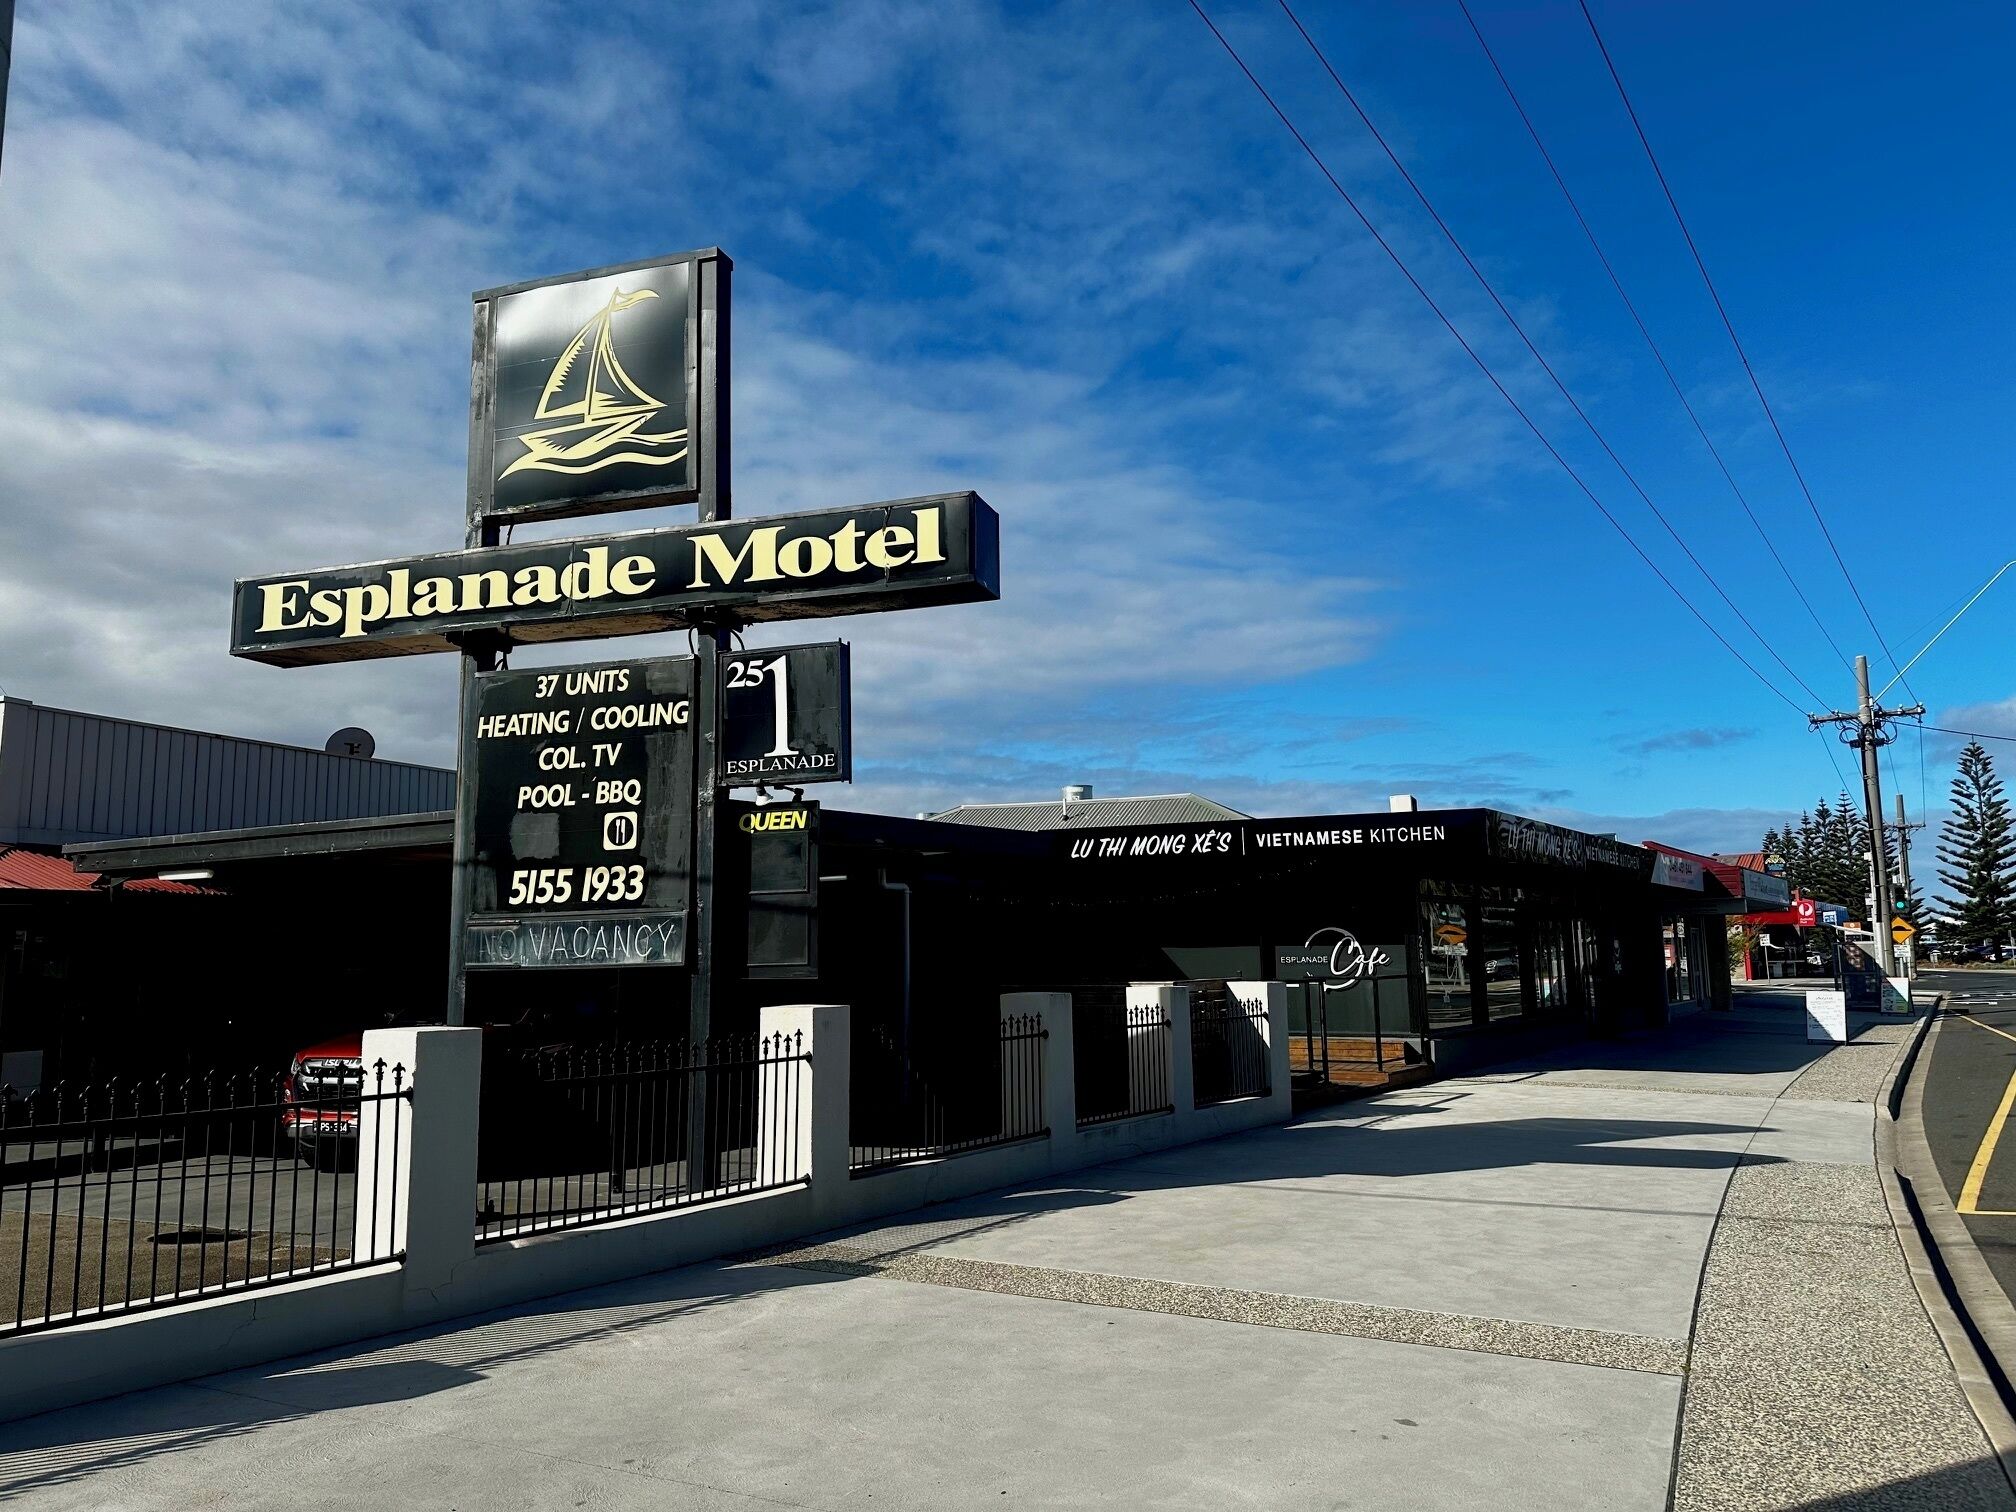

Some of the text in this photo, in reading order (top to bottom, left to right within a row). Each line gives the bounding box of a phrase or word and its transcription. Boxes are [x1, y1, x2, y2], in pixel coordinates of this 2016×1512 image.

[254, 507, 948, 637] Esplanade Motel
[535, 669, 630, 698] 37 UNITS
[477, 701, 689, 738] HEATING / COOLING
[538, 742, 623, 770] COL. TV
[727, 753, 836, 774] ESPLANADE
[518, 783, 576, 809] POOL
[596, 779, 642, 806] BBQ
[739, 811, 808, 834] QUEEN
[1256, 825, 1446, 848] VIETNAMESE KITCHEN
[1071, 838, 1095, 859] LU
[1098, 836, 1128, 858] THI
[1129, 833, 1187, 856] MONG
[509, 865, 645, 905] 5155 1933
[480, 923, 675, 961] NO VACANCY
[1280, 936, 1390, 976] ESPLANADE Cafe
